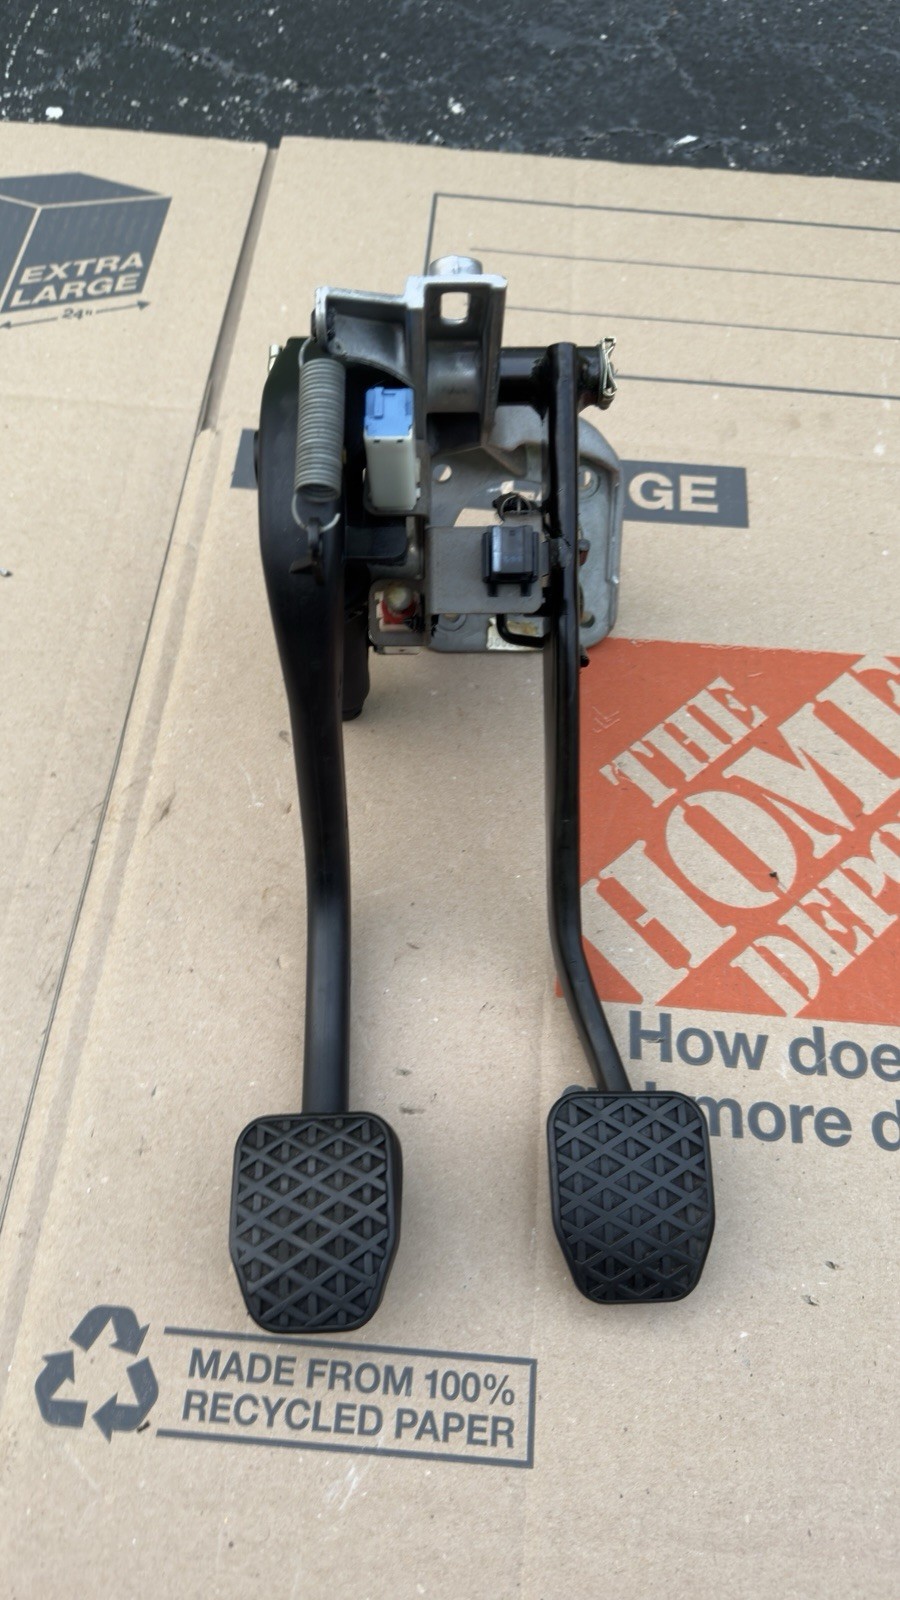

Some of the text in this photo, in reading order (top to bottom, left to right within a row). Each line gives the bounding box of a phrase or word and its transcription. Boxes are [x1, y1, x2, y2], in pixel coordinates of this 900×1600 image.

[10, 272, 140, 308] LARGE
[19, 252, 144, 285] EXTRA
[599, 676, 768, 808] THE
[628, 1010, 900, 1082] How doe
[695, 1095, 852, 1148] more
[188, 1347, 515, 1406] MADE FROM 100%
[182, 1389, 515, 1449] RECYCLED PAPER
